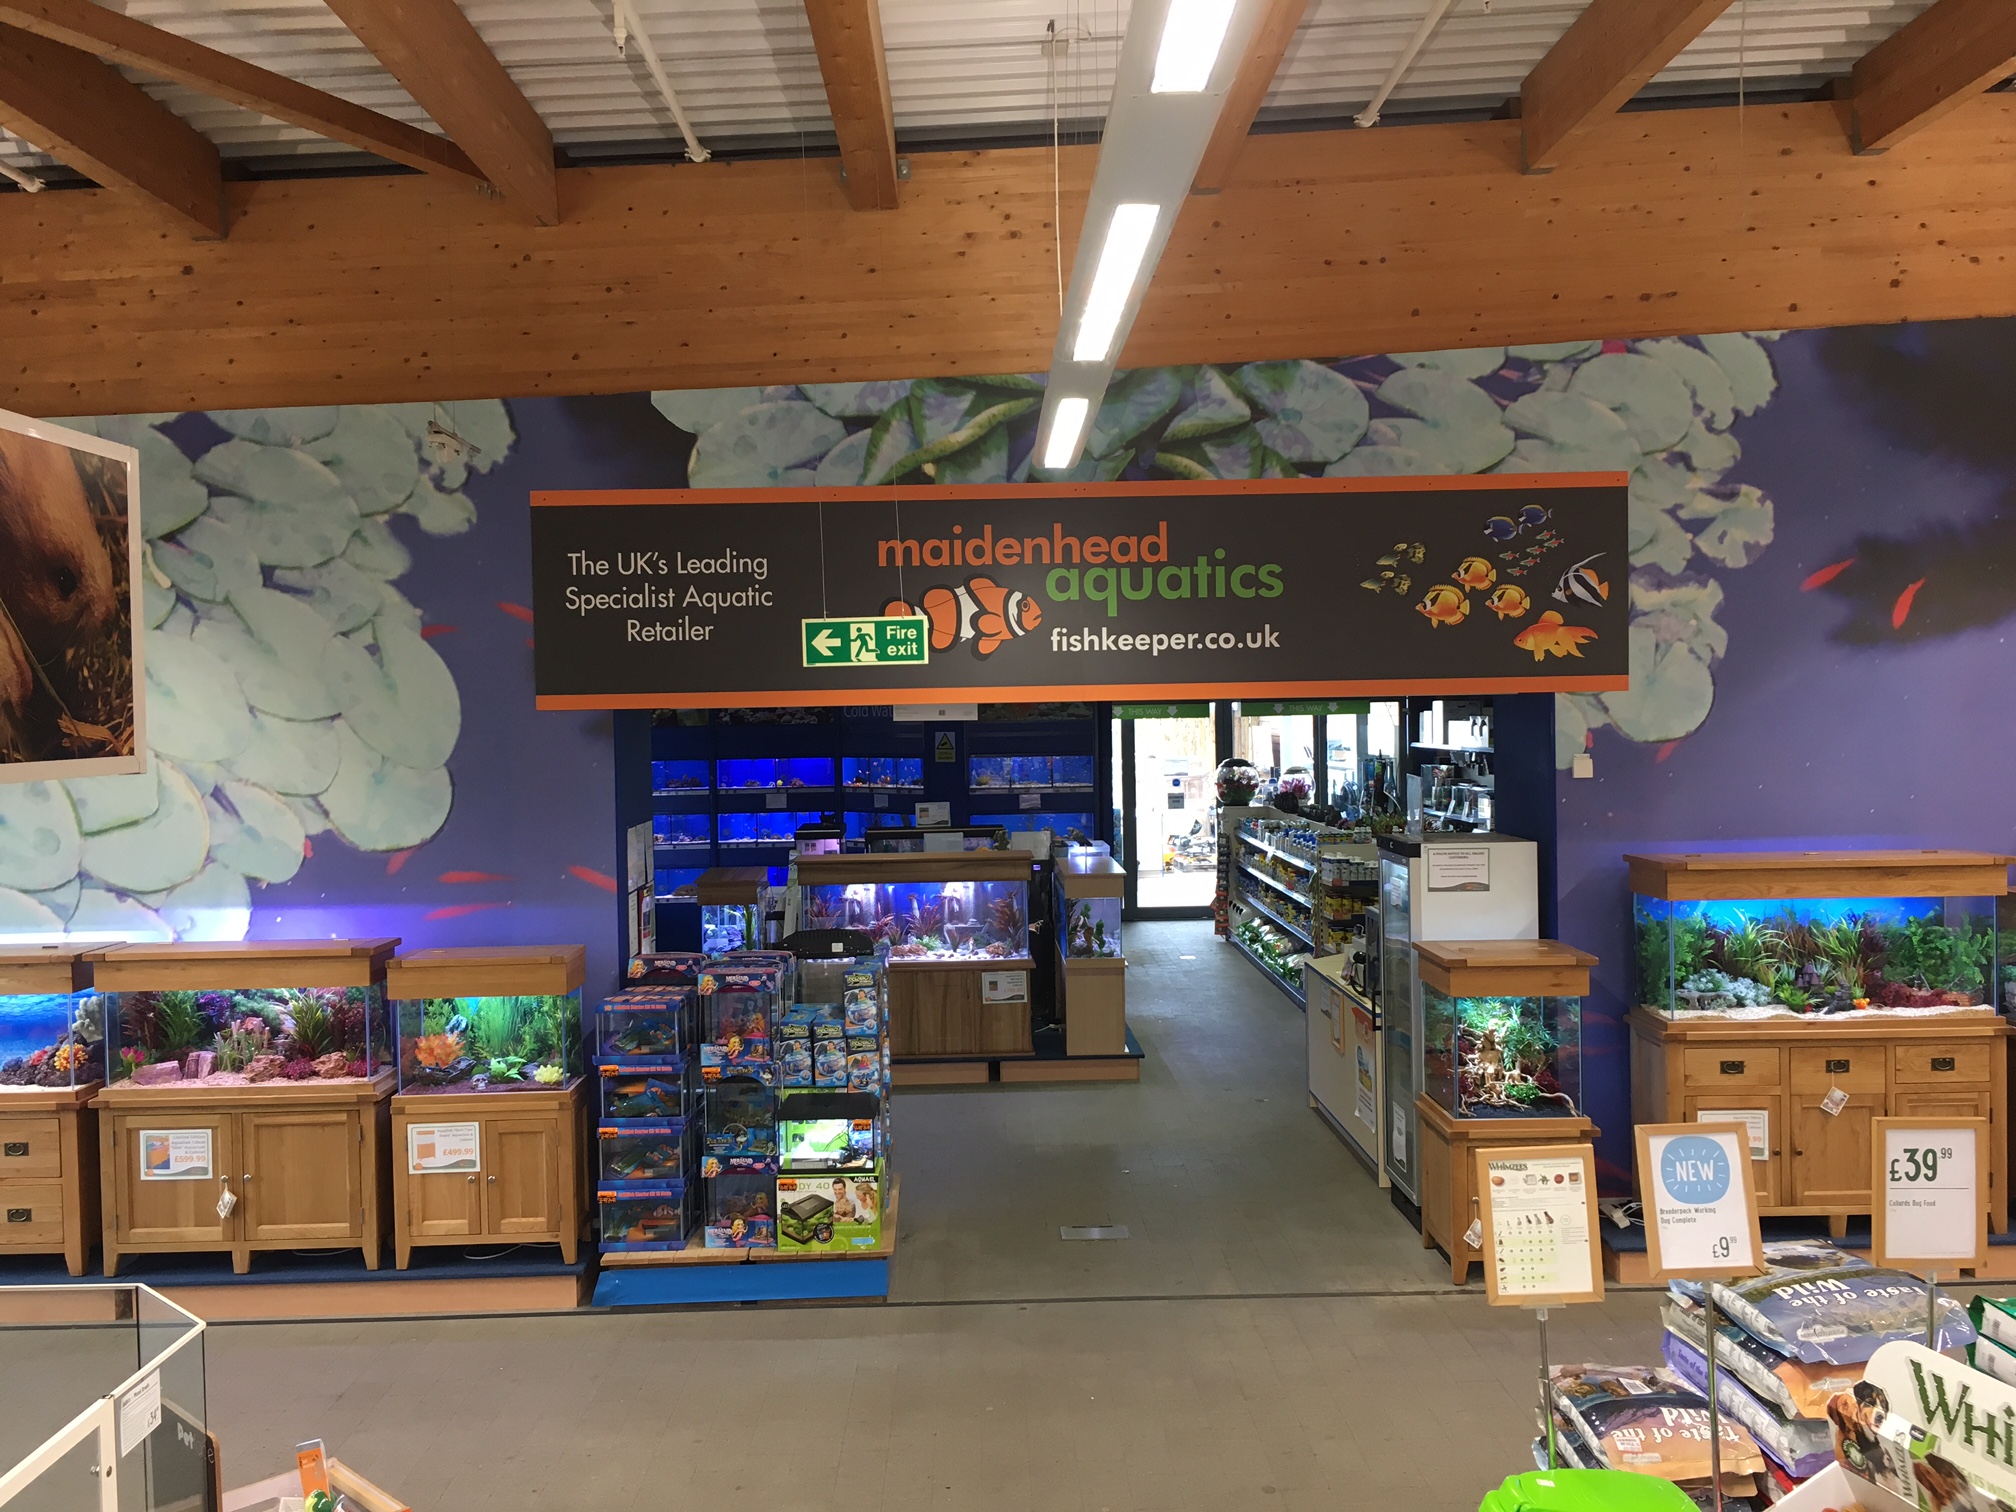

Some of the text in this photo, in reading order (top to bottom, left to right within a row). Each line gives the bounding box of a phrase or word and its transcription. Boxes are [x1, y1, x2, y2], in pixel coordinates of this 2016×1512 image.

[878, 521, 1167, 567] maidenhead
[567, 550, 768, 579] The UK's Leading
[1045, 548, 1283, 617] aquatics
[565, 583, 773, 616] Specialist Aquatic
[627, 617, 714, 642] Retailer
[886, 626, 917, 640] Fire
[1051, 624, 1280, 656] fishkeeper.co.uk
[887, 641, 918, 657] exit
[844, 705, 893, 717] Cold Wat
[174, 1155, 206, 1163] £599.99
[443, 1148, 474, 1156] £499.99
[1675, 1159, 1714, 1182] NEW
[1912, 1199, 1922, 1207] Dog
[1661, 1217, 1671, 1225] Dog
[1772, 1278, 1851, 1299] Wild
[1789, 1292, 1830, 1308] the
[1832, 1291, 1858, 1308] of
[1610, 1427, 1647, 1442] the
[1651, 1427, 1673, 1444] of
